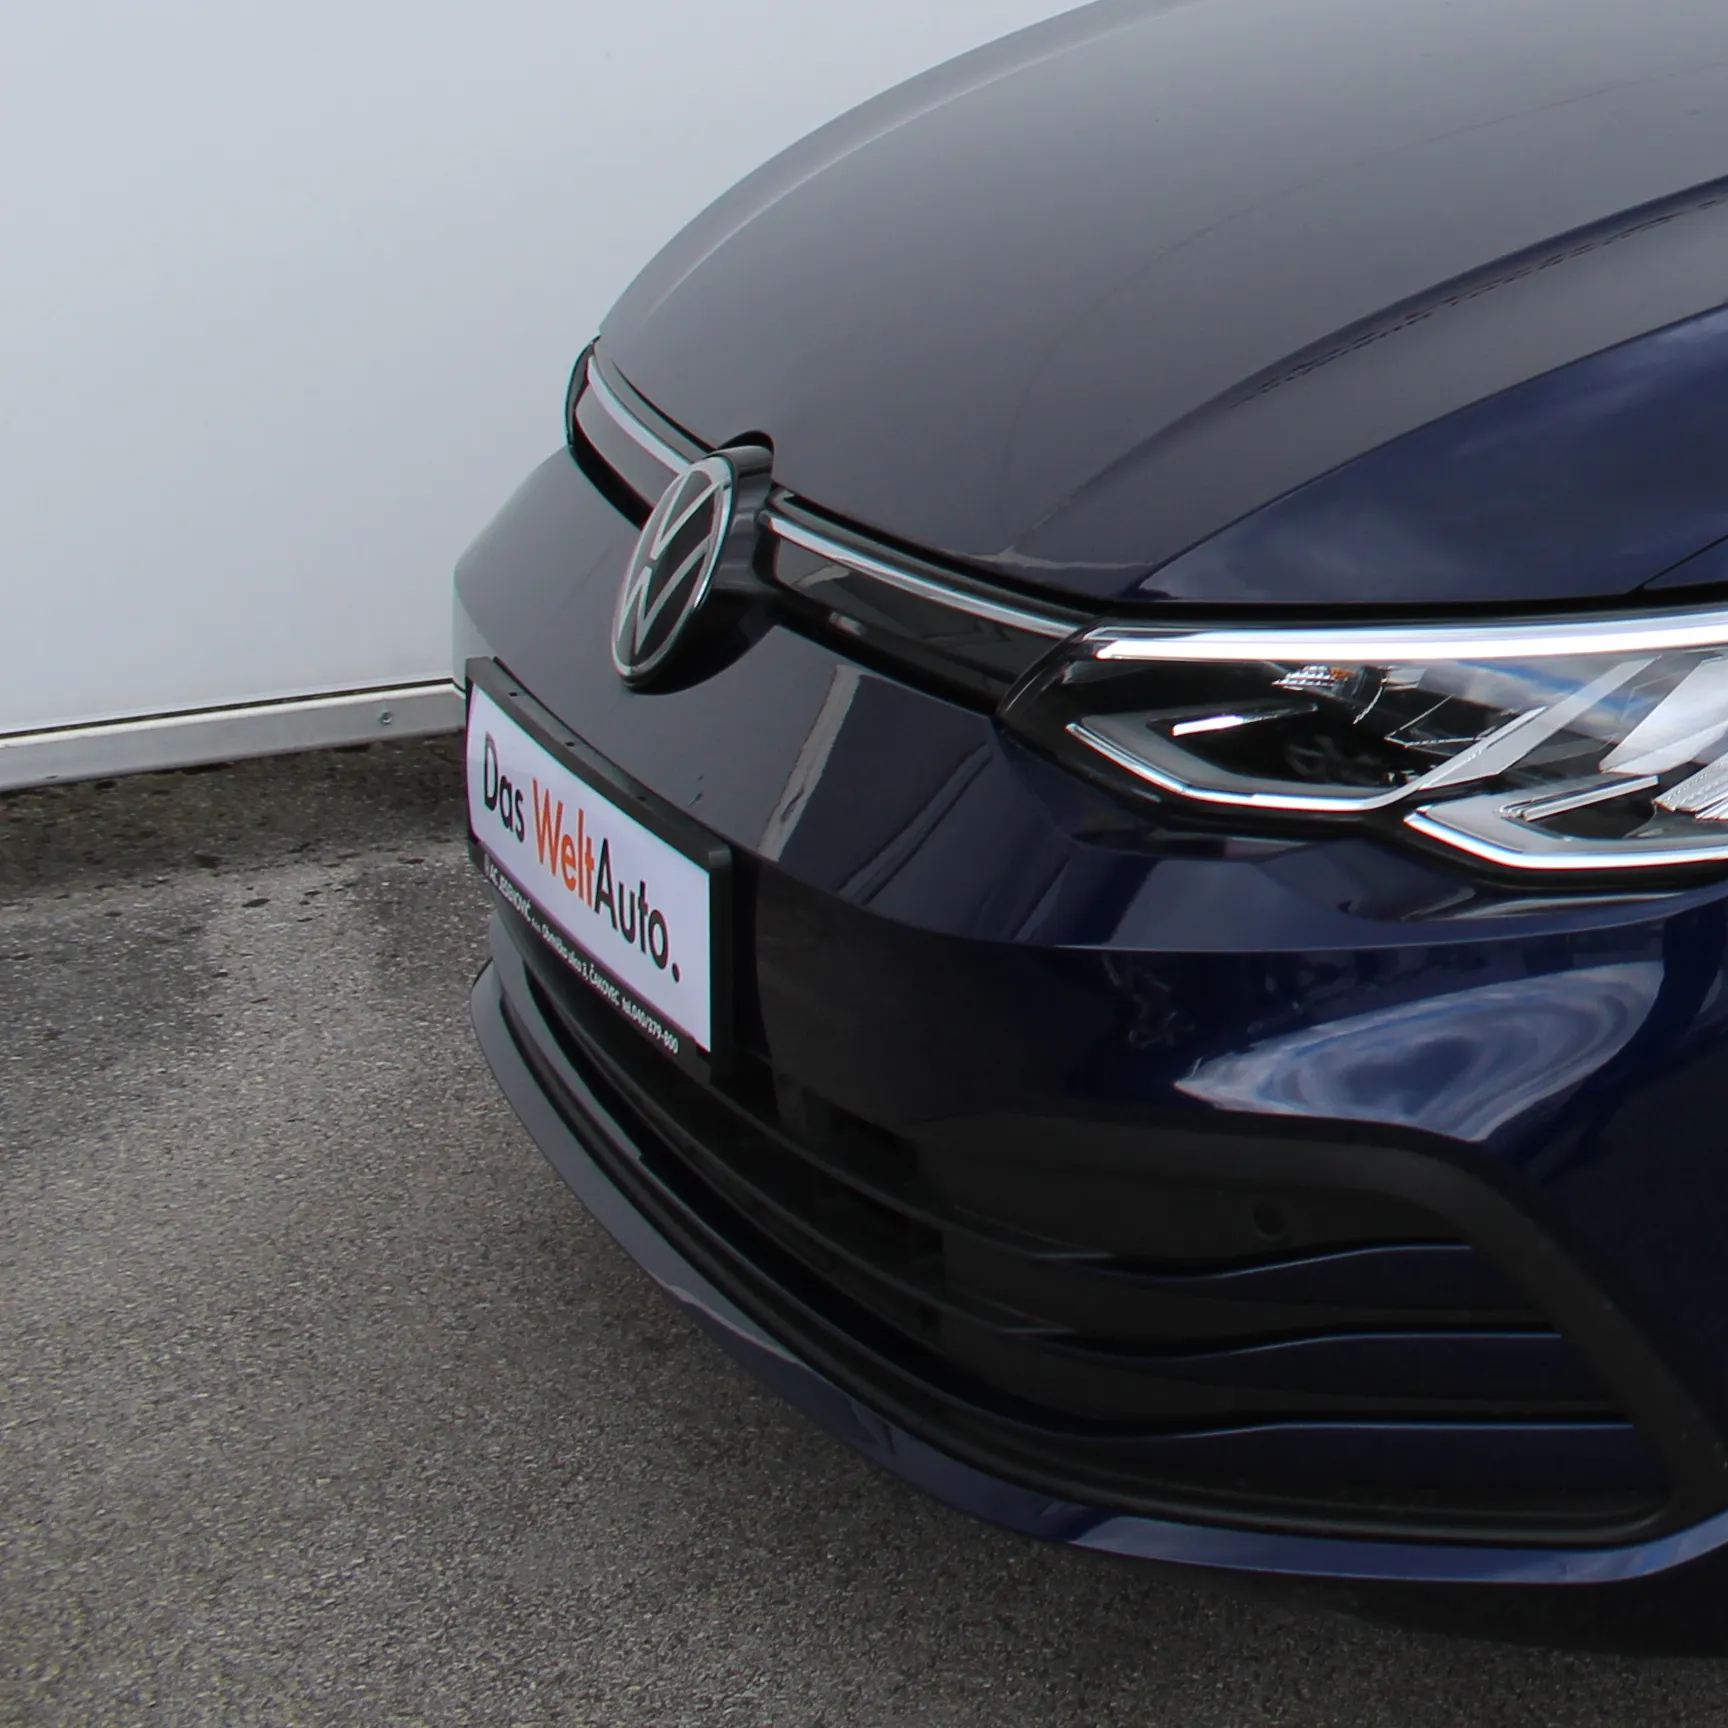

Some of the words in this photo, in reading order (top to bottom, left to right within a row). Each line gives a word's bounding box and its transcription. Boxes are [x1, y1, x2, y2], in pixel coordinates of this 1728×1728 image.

[612, 455, 732, 677] VW
[483, 730, 525, 843] Das
[532, 777, 681, 983] WeltAuto.
